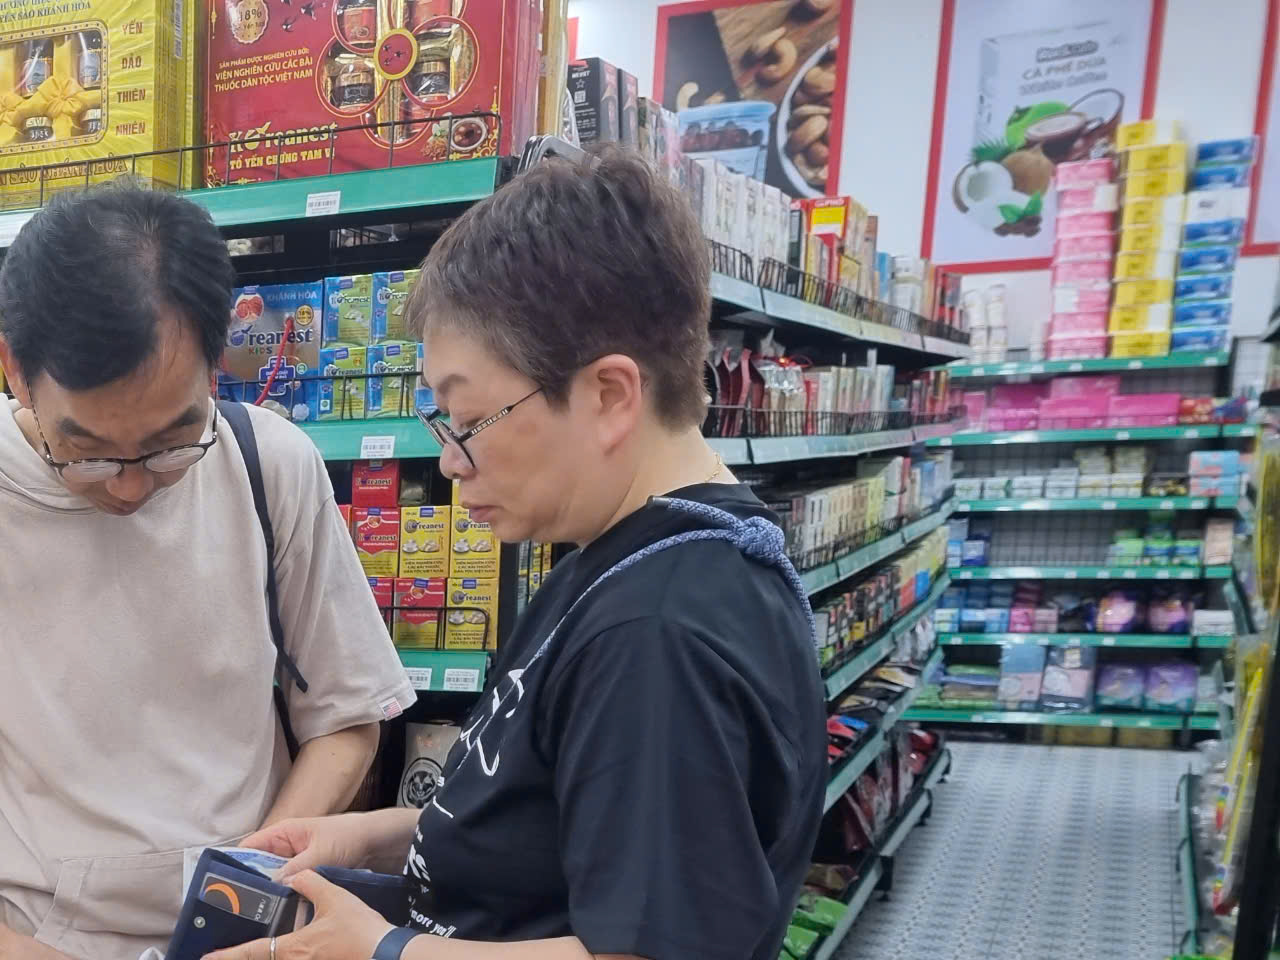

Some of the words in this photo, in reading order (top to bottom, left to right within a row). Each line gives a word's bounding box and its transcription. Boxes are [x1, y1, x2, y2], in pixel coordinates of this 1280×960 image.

[122, 19, 143, 36] YẾN
[282, 58, 299, 70] CÁC
[275, 72, 293, 83] VIỆT
[293, 69, 313, 79] NAM
[230, 324, 314, 347] oreanest
